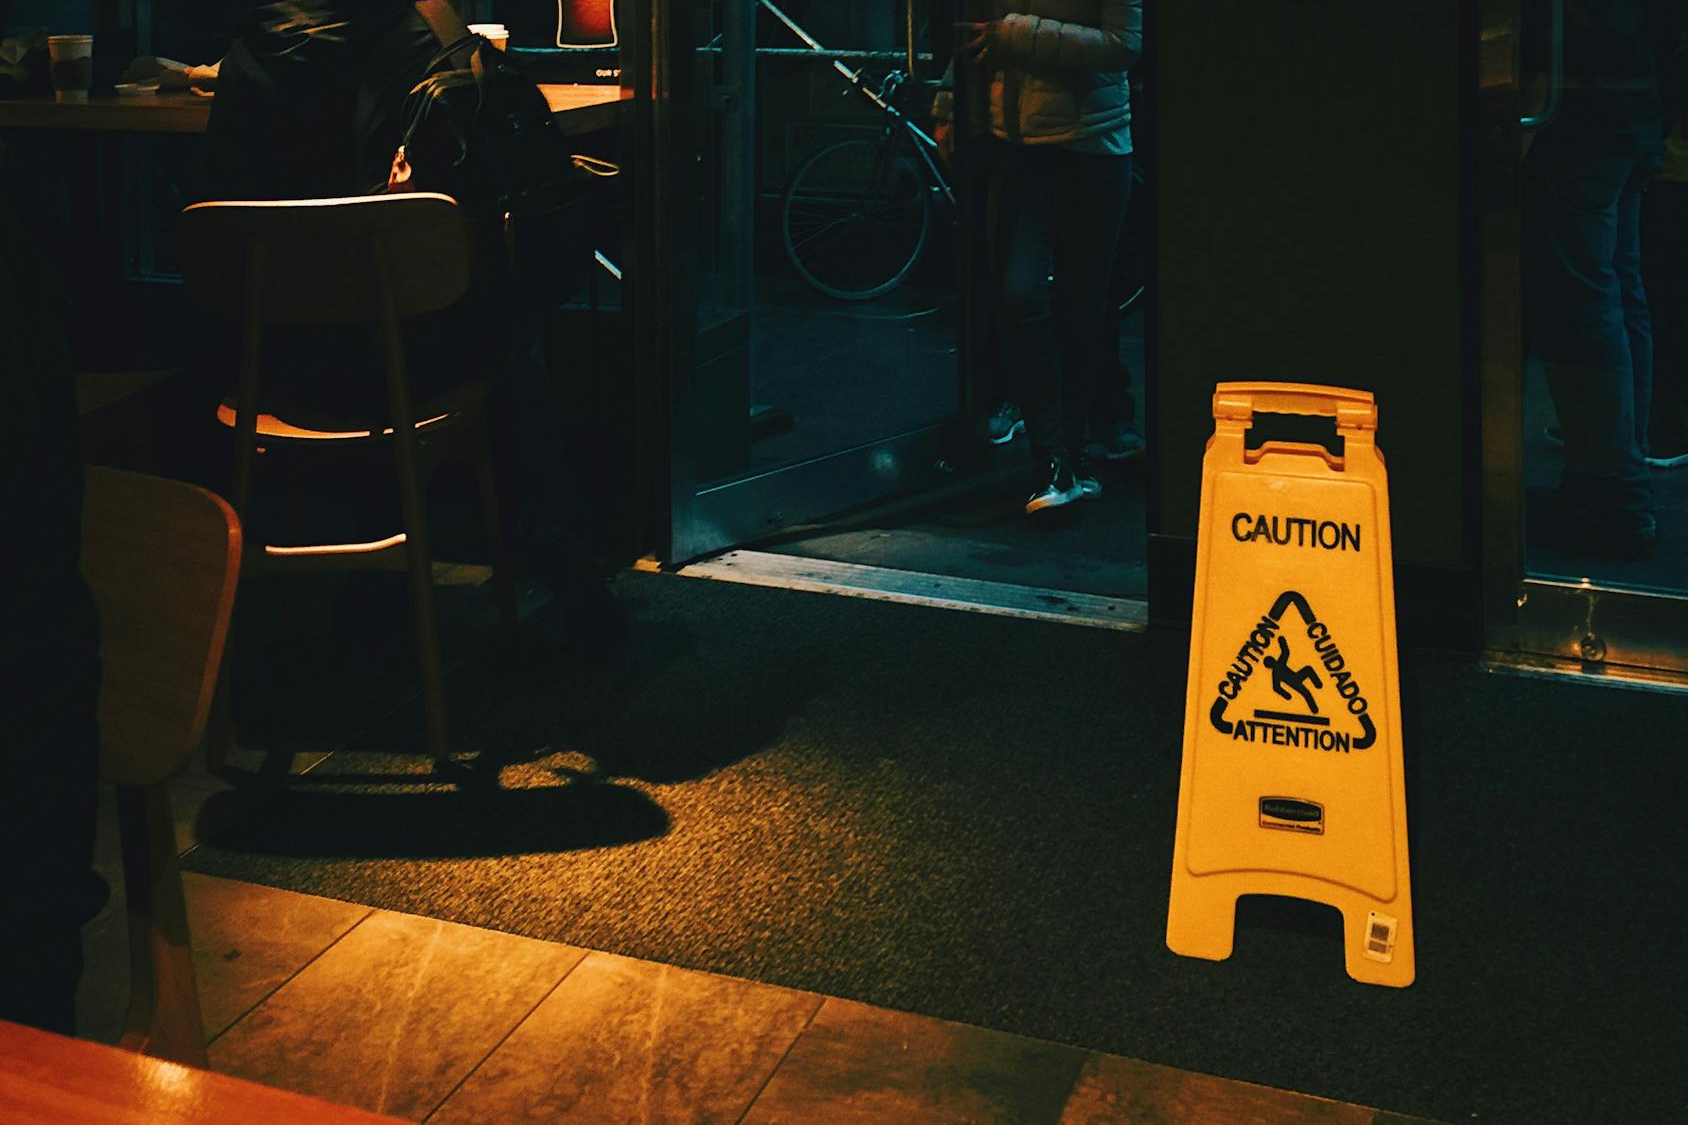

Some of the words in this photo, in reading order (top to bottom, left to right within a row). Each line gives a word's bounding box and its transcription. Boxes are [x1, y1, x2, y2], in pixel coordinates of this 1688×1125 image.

[1231, 512, 1360, 552] CAUTION
[1218, 615, 1280, 700] CAUTION
[1306, 621, 1368, 715] CUIDADO
[1233, 720, 1350, 753] ATTENTION
